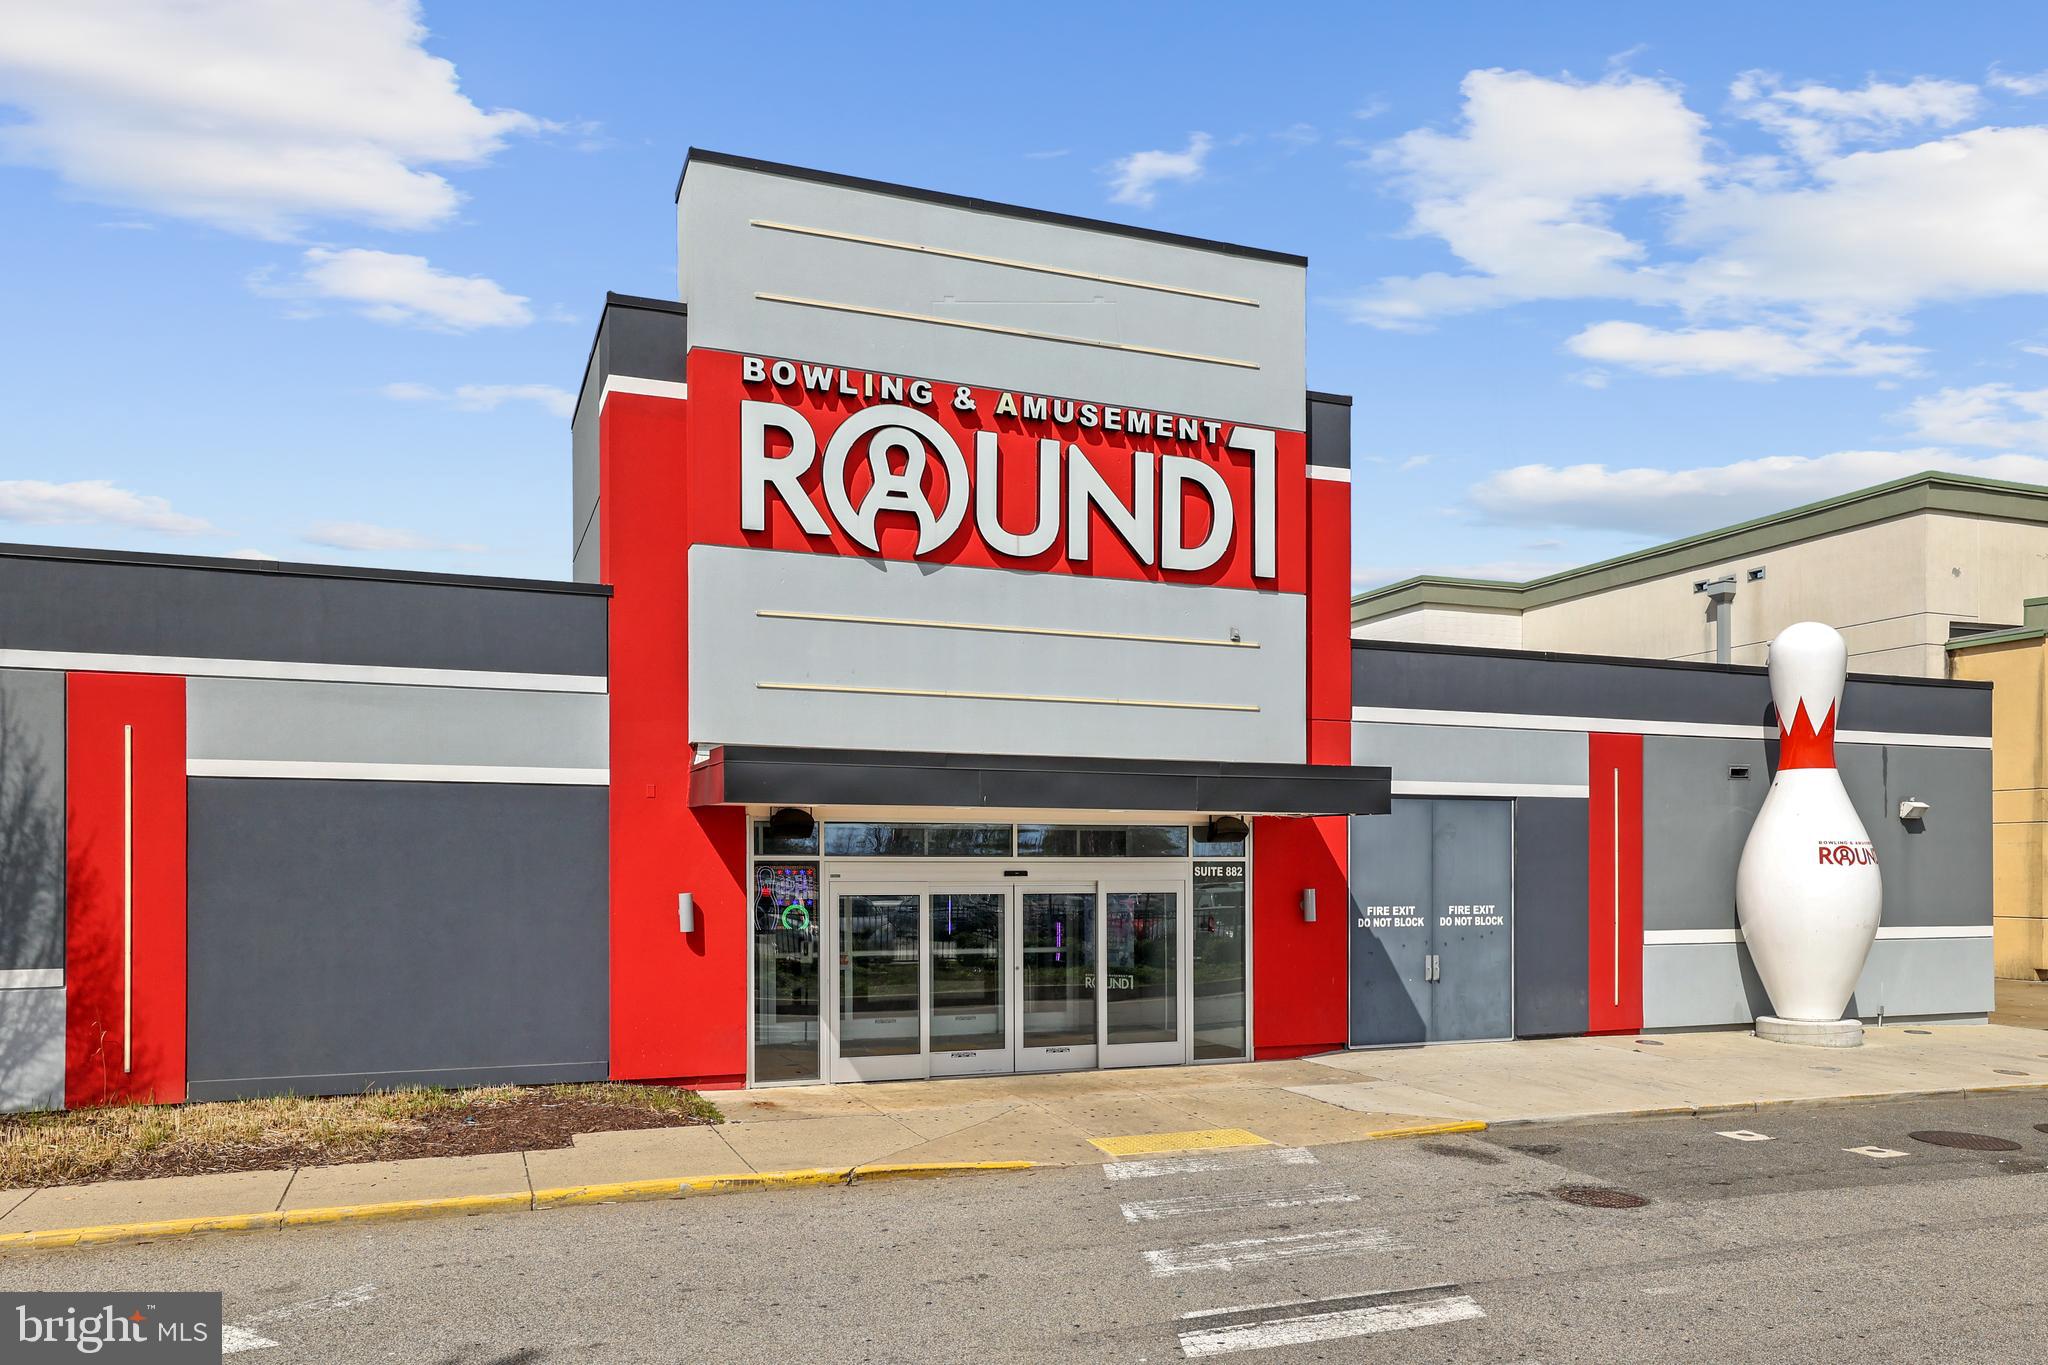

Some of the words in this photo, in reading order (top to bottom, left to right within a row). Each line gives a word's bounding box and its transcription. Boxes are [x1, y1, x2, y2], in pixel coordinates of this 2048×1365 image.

[743, 356, 933, 404] BOWLING
[953, 386, 977, 411] &
[995, 392, 1222, 445] AMUSEMENT
[740, 400, 1276, 579] ROUND1
[1194, 866, 1224, 877] SUITE
[1225, 866, 1243, 877] 882
[1367, 906, 1390, 916] FIRE
[1392, 906, 1416, 916] EXIT
[1448, 905, 1471, 915] FIRE
[1473, 905, 1495, 915] EXIT
[1357, 918, 1371, 928] DO
[1373, 917, 1392, 928] NOT
[1394, 917, 1425, 927] BLOCK
[1439, 917, 1453, 927] DO
[1454, 916, 1473, 926] NOT
[1475, 916, 1504, 926] BLOCK
